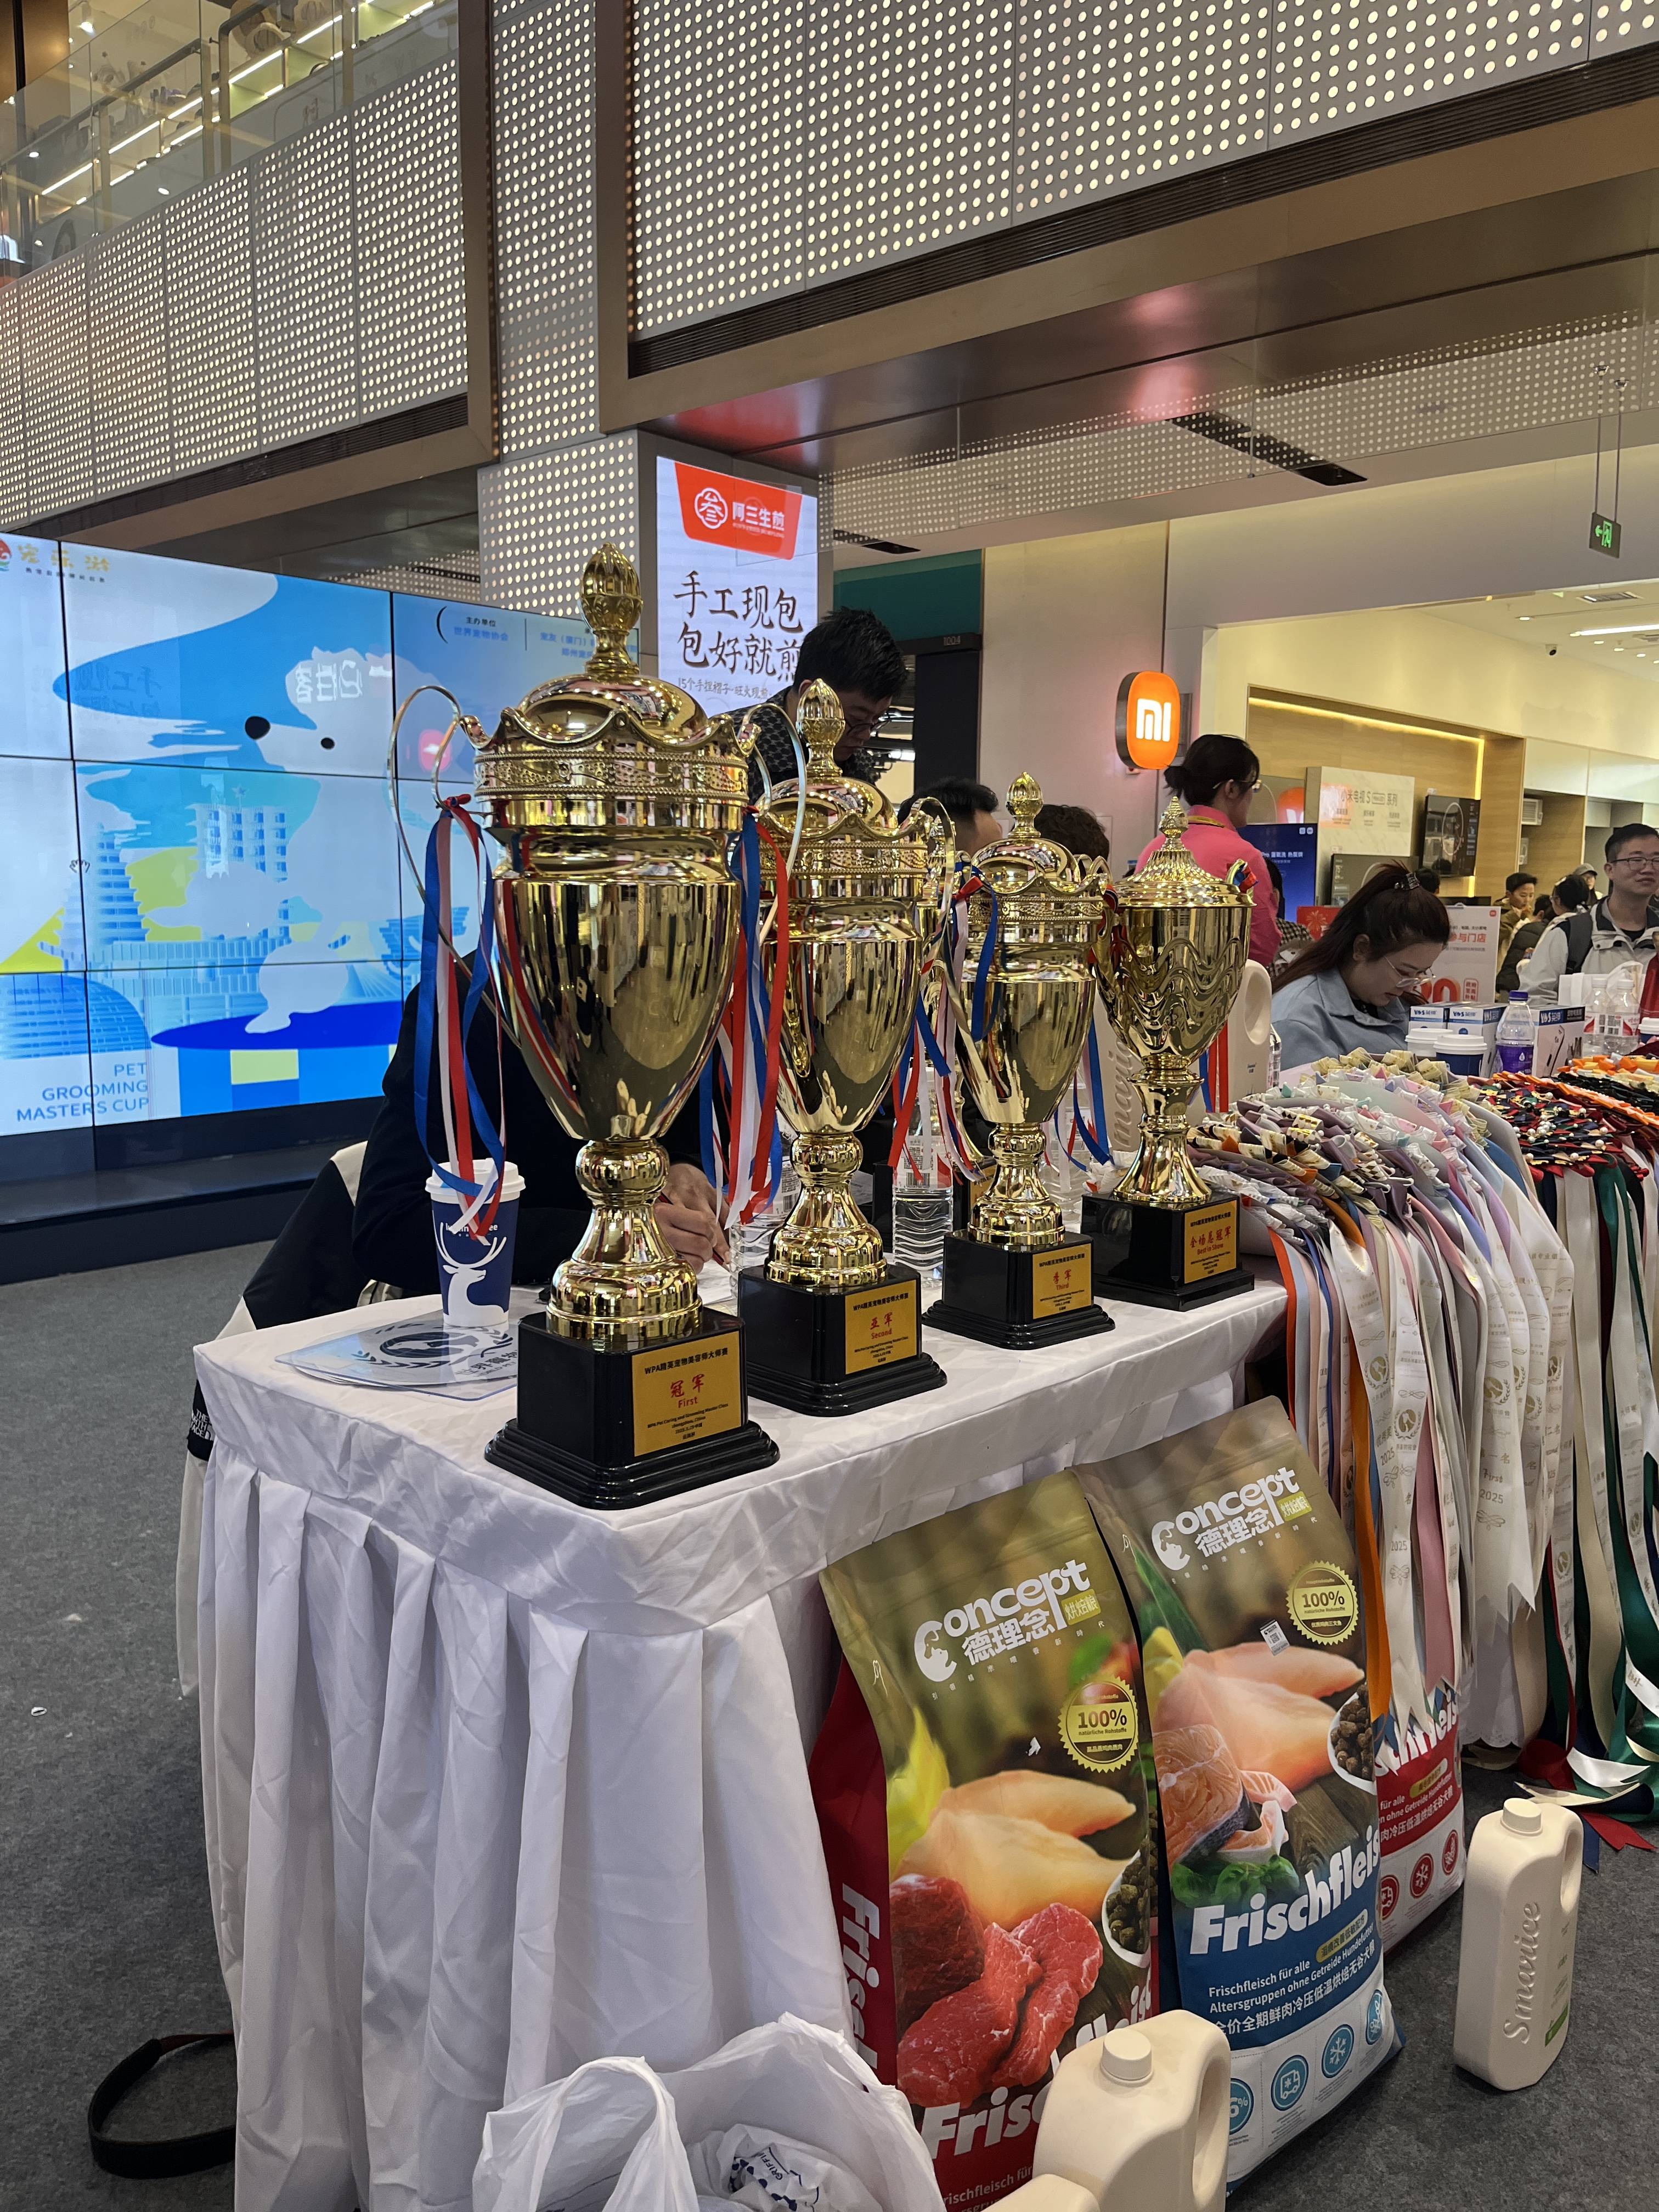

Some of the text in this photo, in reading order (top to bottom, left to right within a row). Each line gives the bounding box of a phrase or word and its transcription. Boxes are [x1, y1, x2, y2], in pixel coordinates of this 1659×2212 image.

[673, 570, 804, 634] 手工现包
[676, 622, 801, 682] 包好就煎
[114, 1062, 147, 1077] PET
[42, 1079, 148, 1102] GROOMING
[16, 1097, 149, 1122] MASTERS CUP
[871, 1328, 893, 1340] Second
[678, 1396, 698, 1408] First
[196, 1408, 209, 1423] THE
[1380, 1447, 1395, 1466] 2025
[1483, 1468, 1503, 1483] First
[1479, 1488, 1504, 1504] 2025
[1194, 1508, 1275, 1558] 德理念
[1391, 1540, 1408, 1551] 2025
[1301, 1590, 1345, 1608] 100%
[962, 1608, 1056, 1666] 德理念
[1078, 1708, 1127, 1729] 100%
[1380, 1795, 1406, 1810] für alle
[1386, 1809, 1404, 1821] ohne
[1210, 1922, 1375, 2014] Altersgruppen ohne Getreide Hundefutter
[1503, 1902, 1541, 2044] Smavice
[1209, 1961, 1311, 1998] Frischfleisch für alle
[943, 2174, 1014, 2205] rischfleisch
[1017, 2166, 1032, 2181] für
